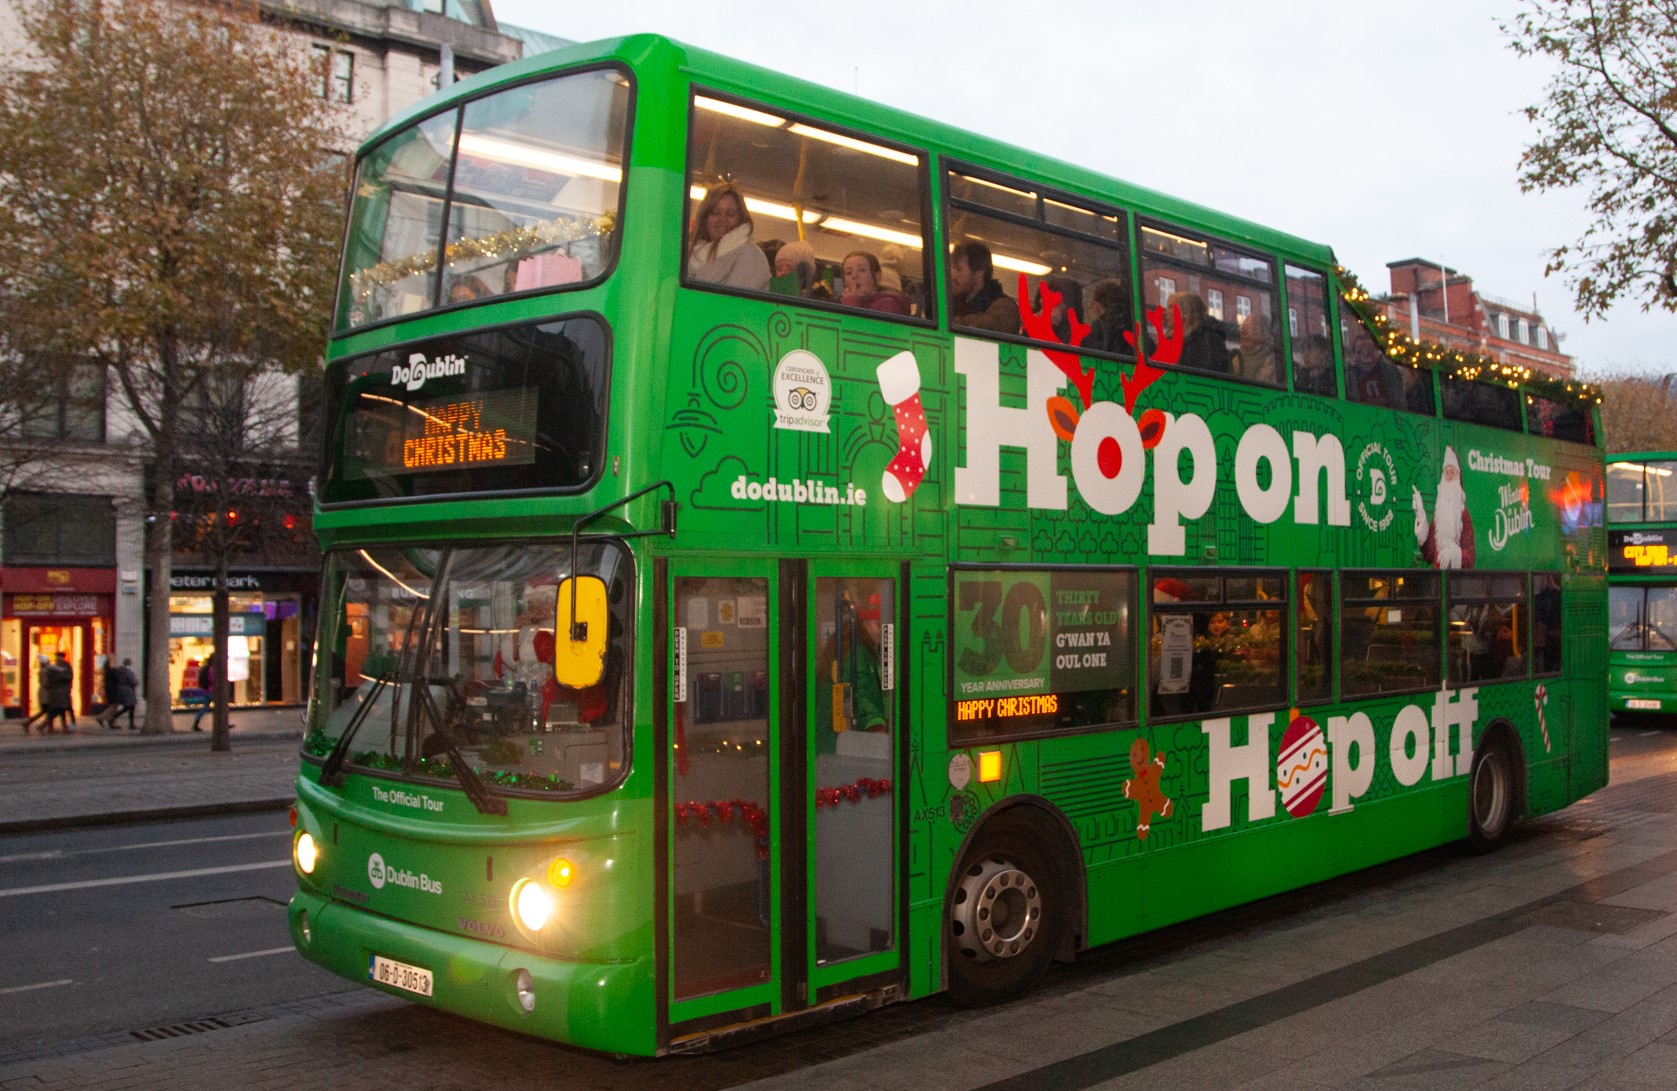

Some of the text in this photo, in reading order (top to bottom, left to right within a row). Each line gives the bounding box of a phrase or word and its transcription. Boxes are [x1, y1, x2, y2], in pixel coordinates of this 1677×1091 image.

[391, 352, 466, 391] DoDublin
[781, 372, 824, 385] EXCELLENCE
[786, 366, 814, 375] CERTIFICATE
[424, 400, 484, 435] HAPPY
[780, 414, 824, 427] tripadvisor
[404, 428, 506, 468] CHRISTMAS
[954, 336, 1351, 557] Hop on
[1356, 442, 1397, 485] OFFICIAL TOUR
[1468, 450, 1551, 480] Christmas Tour
[731, 475, 866, 505] dodublin.ie
[1359, 502, 1378, 532] SINCE
[1489, 508, 1535, 551] Dublin
[1055, 590, 1100, 605] THIRTY
[957, 581, 1047, 677] 30
[1055, 611, 1093, 626] YEARS
[1055, 631, 1111, 648] G'WAN YA
[1055, 652, 1107, 670] OUL ONE
[960, 677, 1046, 694] YEAR ANNIVERSARY
[957, 695, 1058, 721] HAPPY CHRISTMAS
[1201, 682, 1479, 832] Hop off
[372, 786, 444, 812] The Official Tour
[914, 806, 946, 821] AX513
[386, 866, 443, 895] Dublin Bus
[459, 917, 505, 938] VOLVO
[379, 962, 430, 993] 06-D-30513
